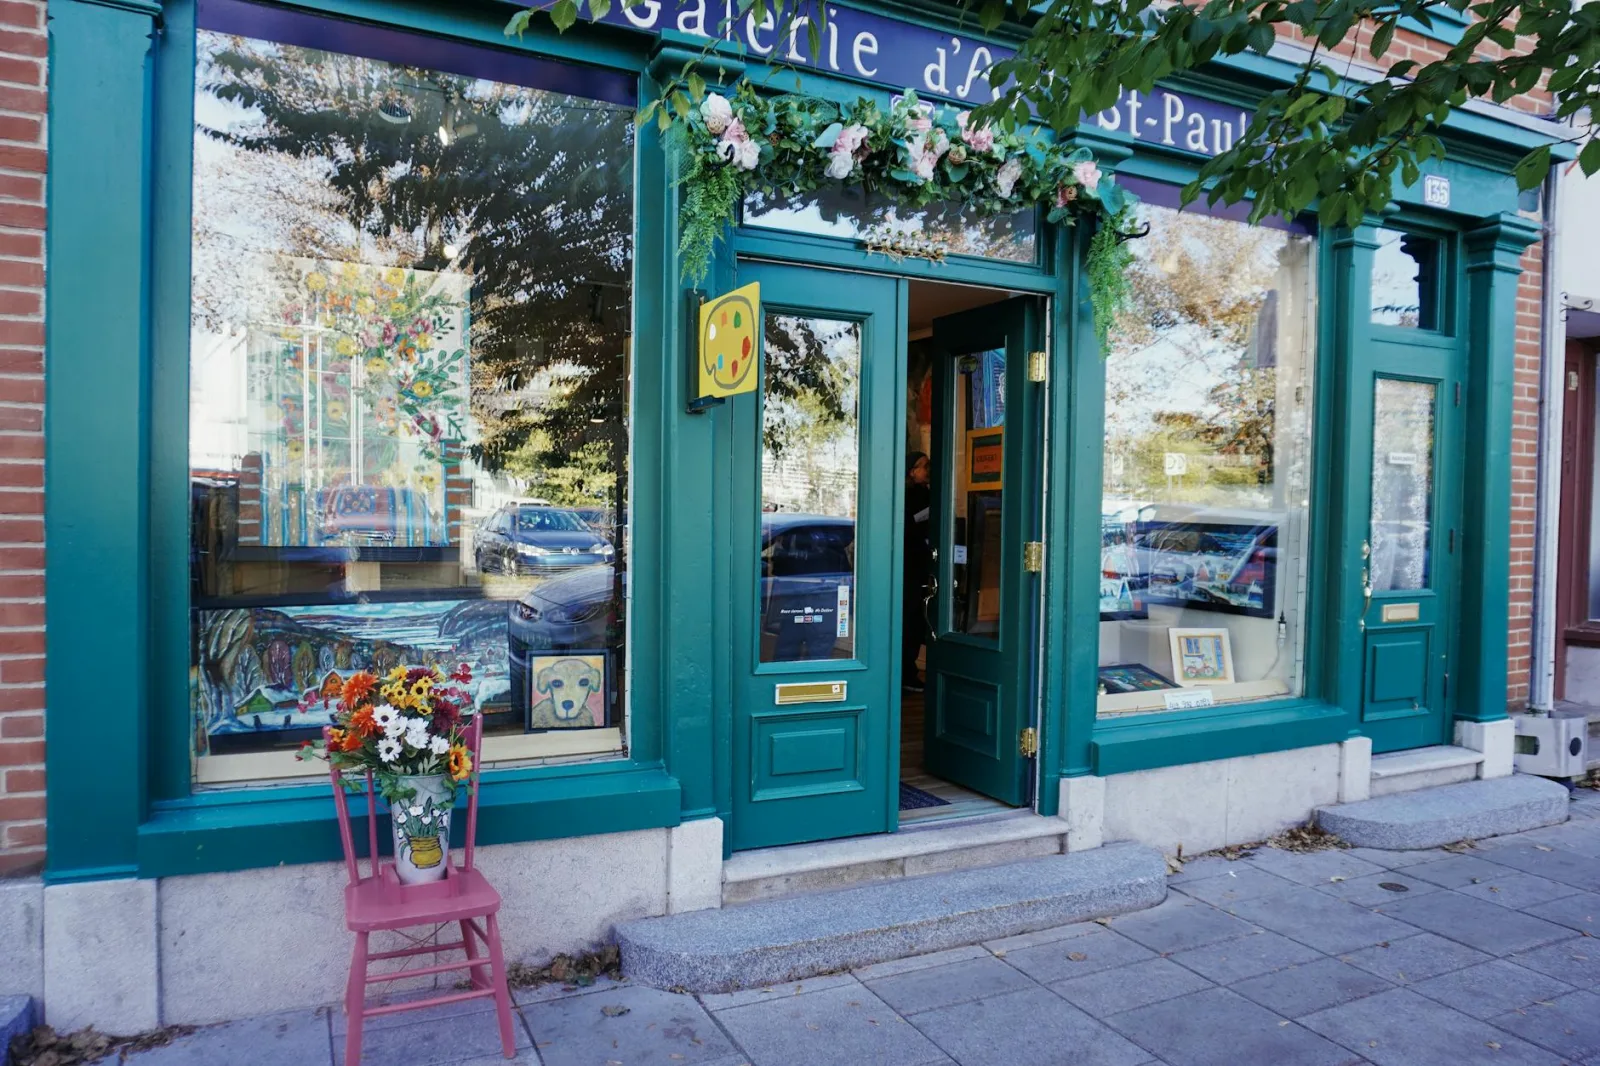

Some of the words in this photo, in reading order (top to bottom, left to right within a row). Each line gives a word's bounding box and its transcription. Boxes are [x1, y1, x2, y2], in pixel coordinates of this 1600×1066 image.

[620, 0, 879, 77] Galerie
[1097, 83, 1247, 155] St-Paul
[1427, 178, 1448, 204] 135
